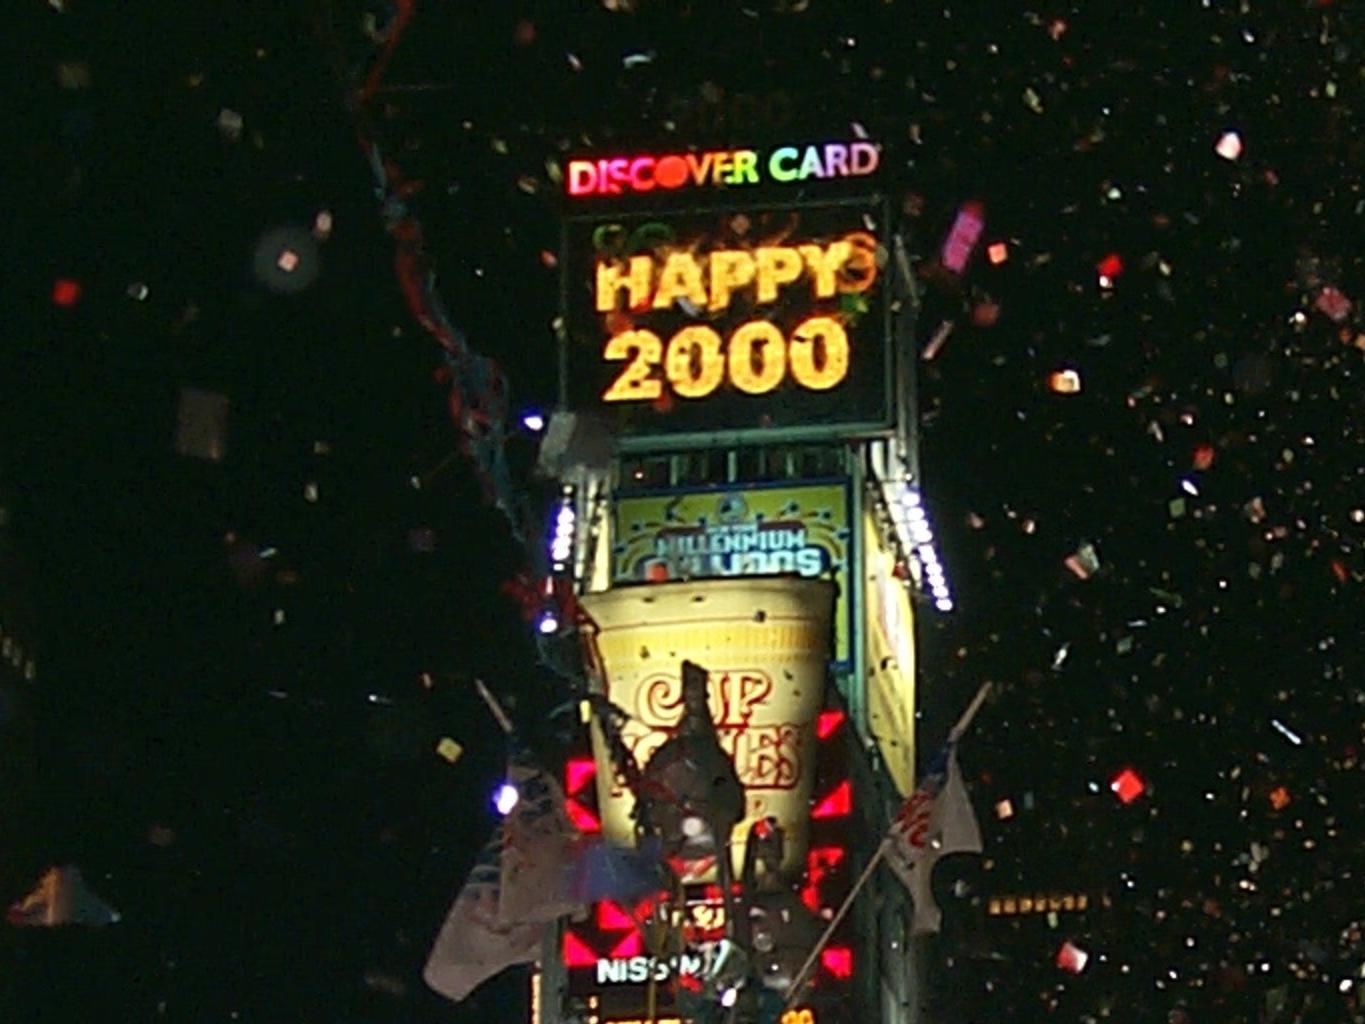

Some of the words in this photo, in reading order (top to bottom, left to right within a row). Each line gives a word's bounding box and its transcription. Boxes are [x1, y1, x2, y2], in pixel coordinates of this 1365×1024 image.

[568, 150, 759, 196] DISCOVER
[769, 143, 879, 182] CARD
[596, 240, 852, 312] HAPPY
[602, 316, 849, 402] 2000
